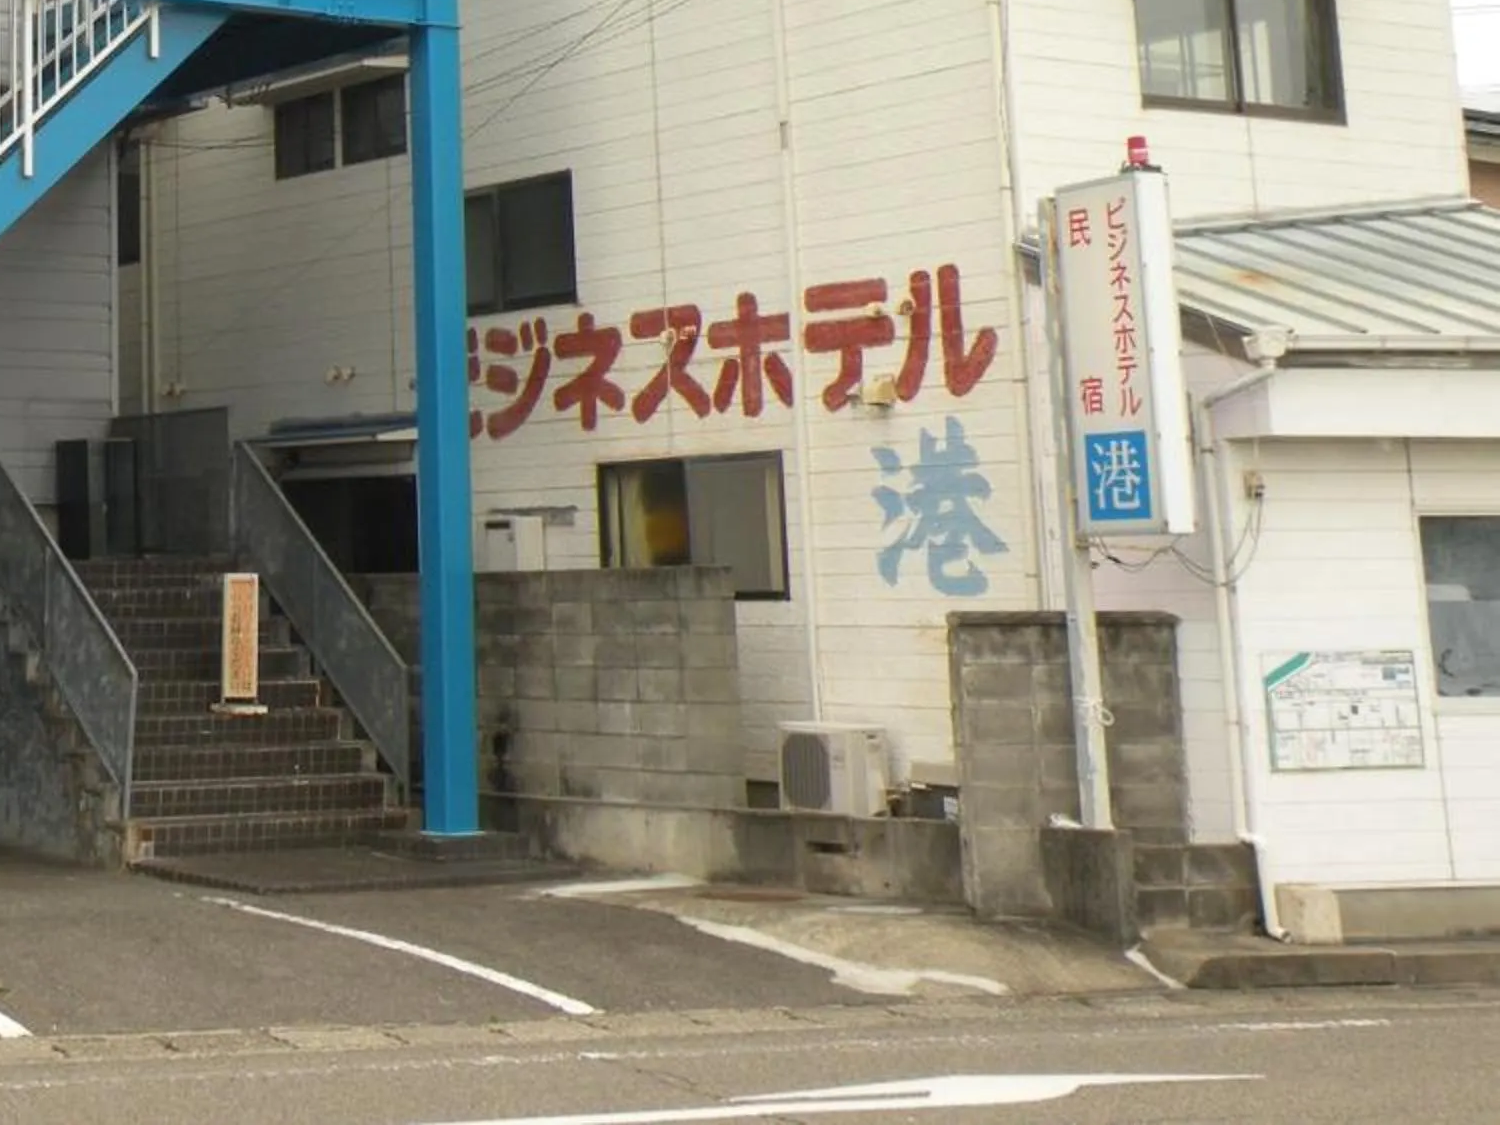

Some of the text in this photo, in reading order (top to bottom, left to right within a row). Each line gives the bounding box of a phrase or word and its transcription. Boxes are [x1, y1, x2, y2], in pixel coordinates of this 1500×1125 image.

[467, 264, 999, 442] ジネスホテル
[1105, 196, 1142, 419] ビジネスホテル
[870, 414, 1009, 598] 港
[1091, 438, 1141, 511] 港
